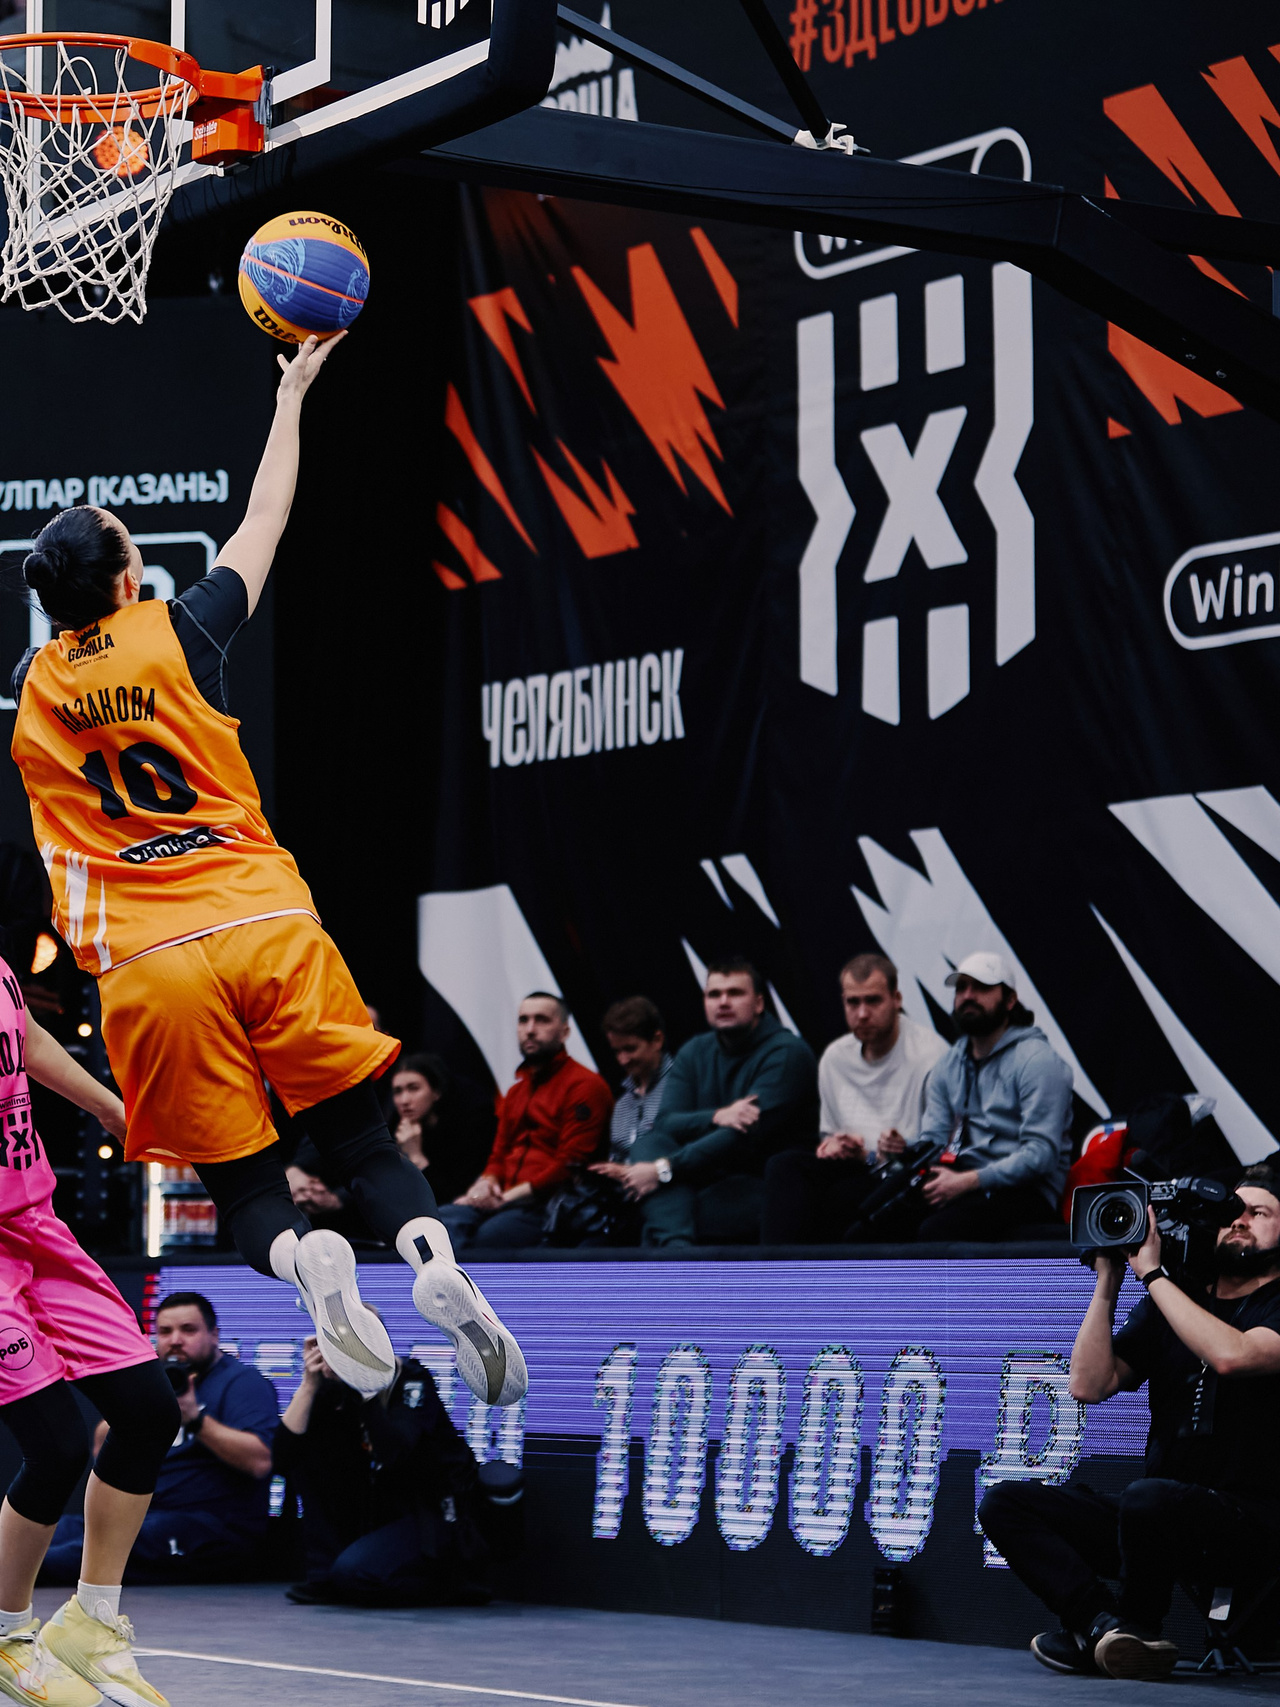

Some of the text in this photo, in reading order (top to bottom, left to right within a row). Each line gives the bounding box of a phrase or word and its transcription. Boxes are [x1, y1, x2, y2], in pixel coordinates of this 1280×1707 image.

[87, 469, 229, 508] (КАЗАНЬ)
[51, 686, 155, 735] КАЗАКОВА
[78, 741, 198, 820] 10
[592, 1342, 947, 1562] 10000
